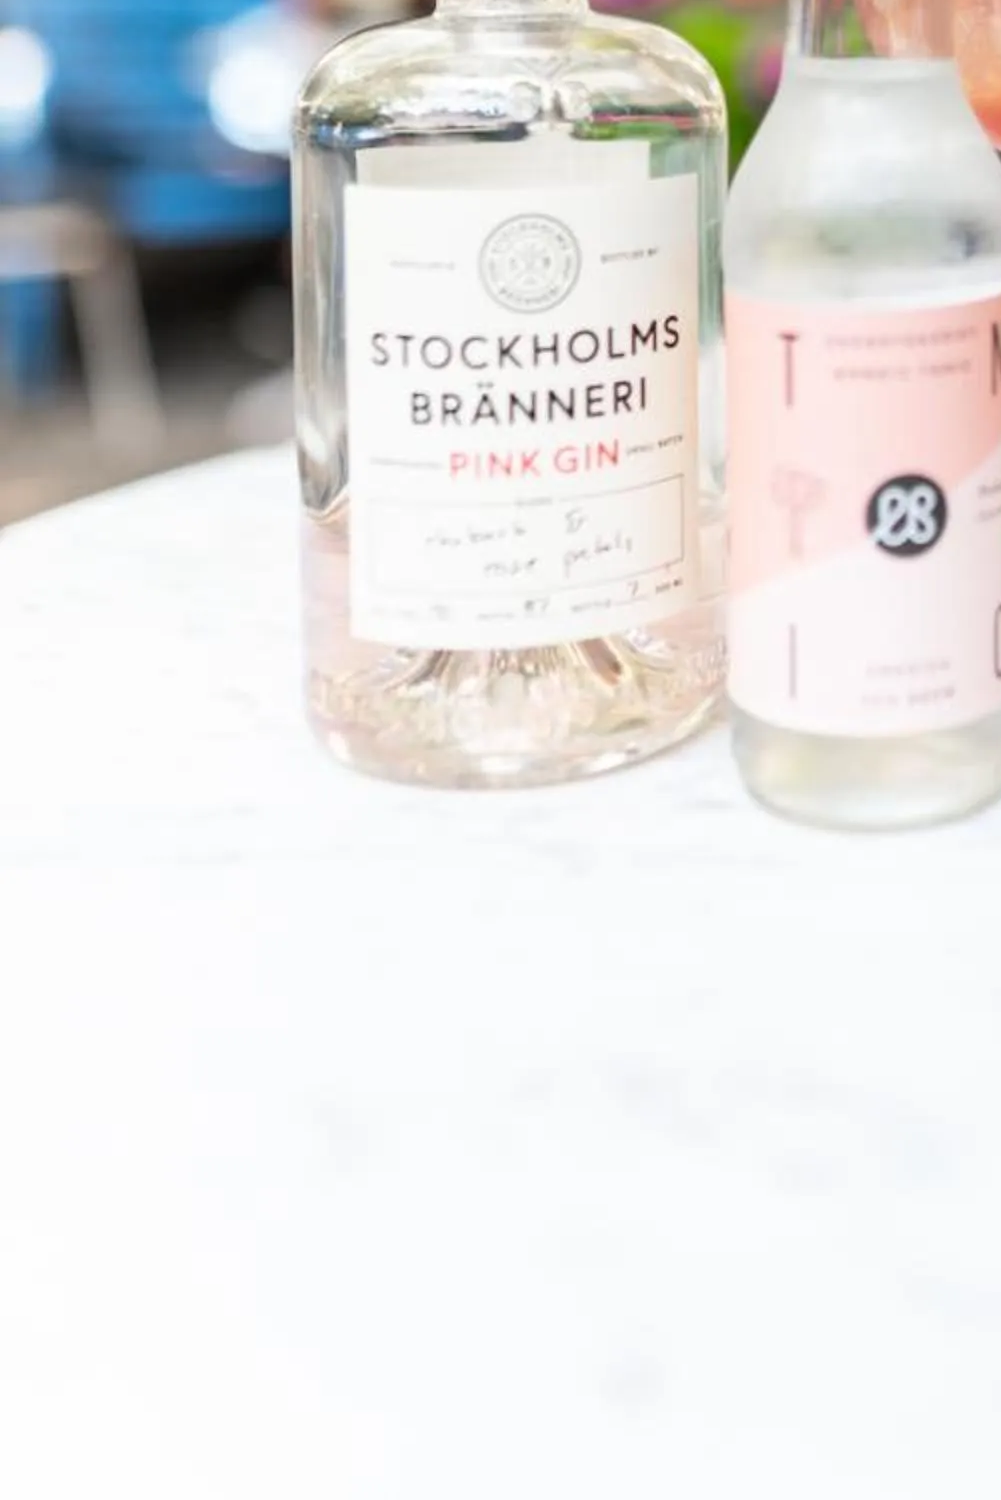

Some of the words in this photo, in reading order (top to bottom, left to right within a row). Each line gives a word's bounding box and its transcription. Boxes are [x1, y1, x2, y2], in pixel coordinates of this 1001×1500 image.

[370, 315, 681, 370] STOCKHOLMS
[778, 332, 800, 409] T
[411, 376, 647, 426] BRÄNNERI
[449, 449, 542, 480] PINK
[553, 439, 620, 475] GIN
